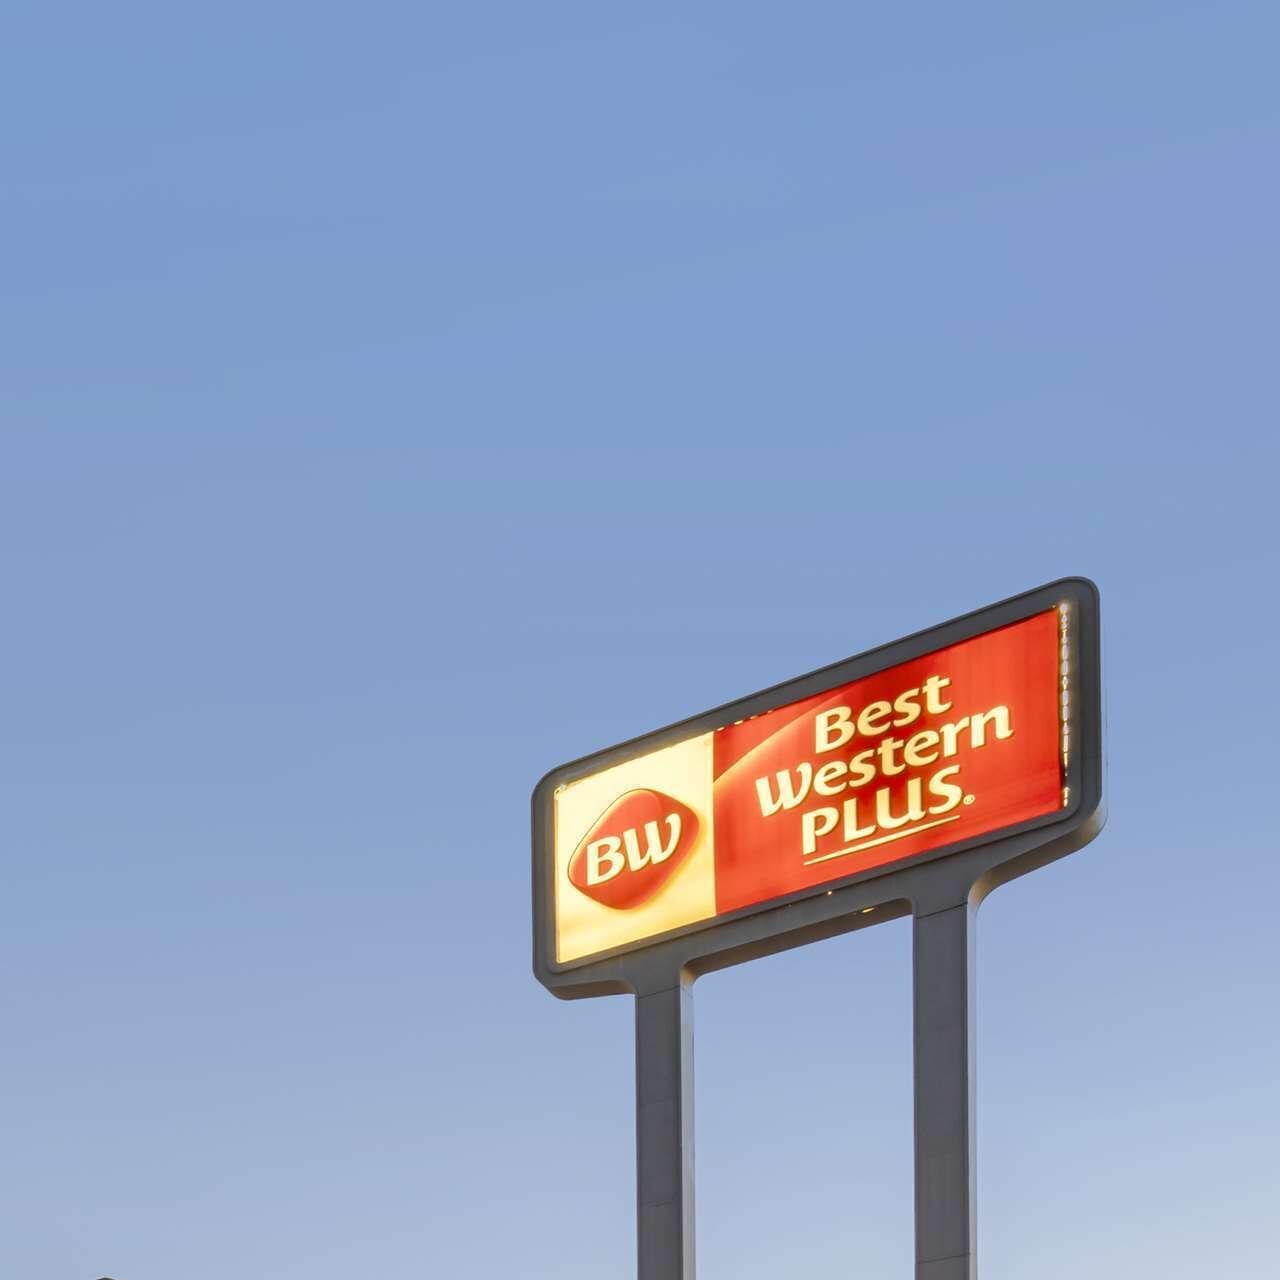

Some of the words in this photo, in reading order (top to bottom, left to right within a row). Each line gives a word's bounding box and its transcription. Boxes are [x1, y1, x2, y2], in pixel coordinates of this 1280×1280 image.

[815, 675, 952, 754] Best
[755, 705, 1014, 817] Western
[586, 813, 682, 886] BW
